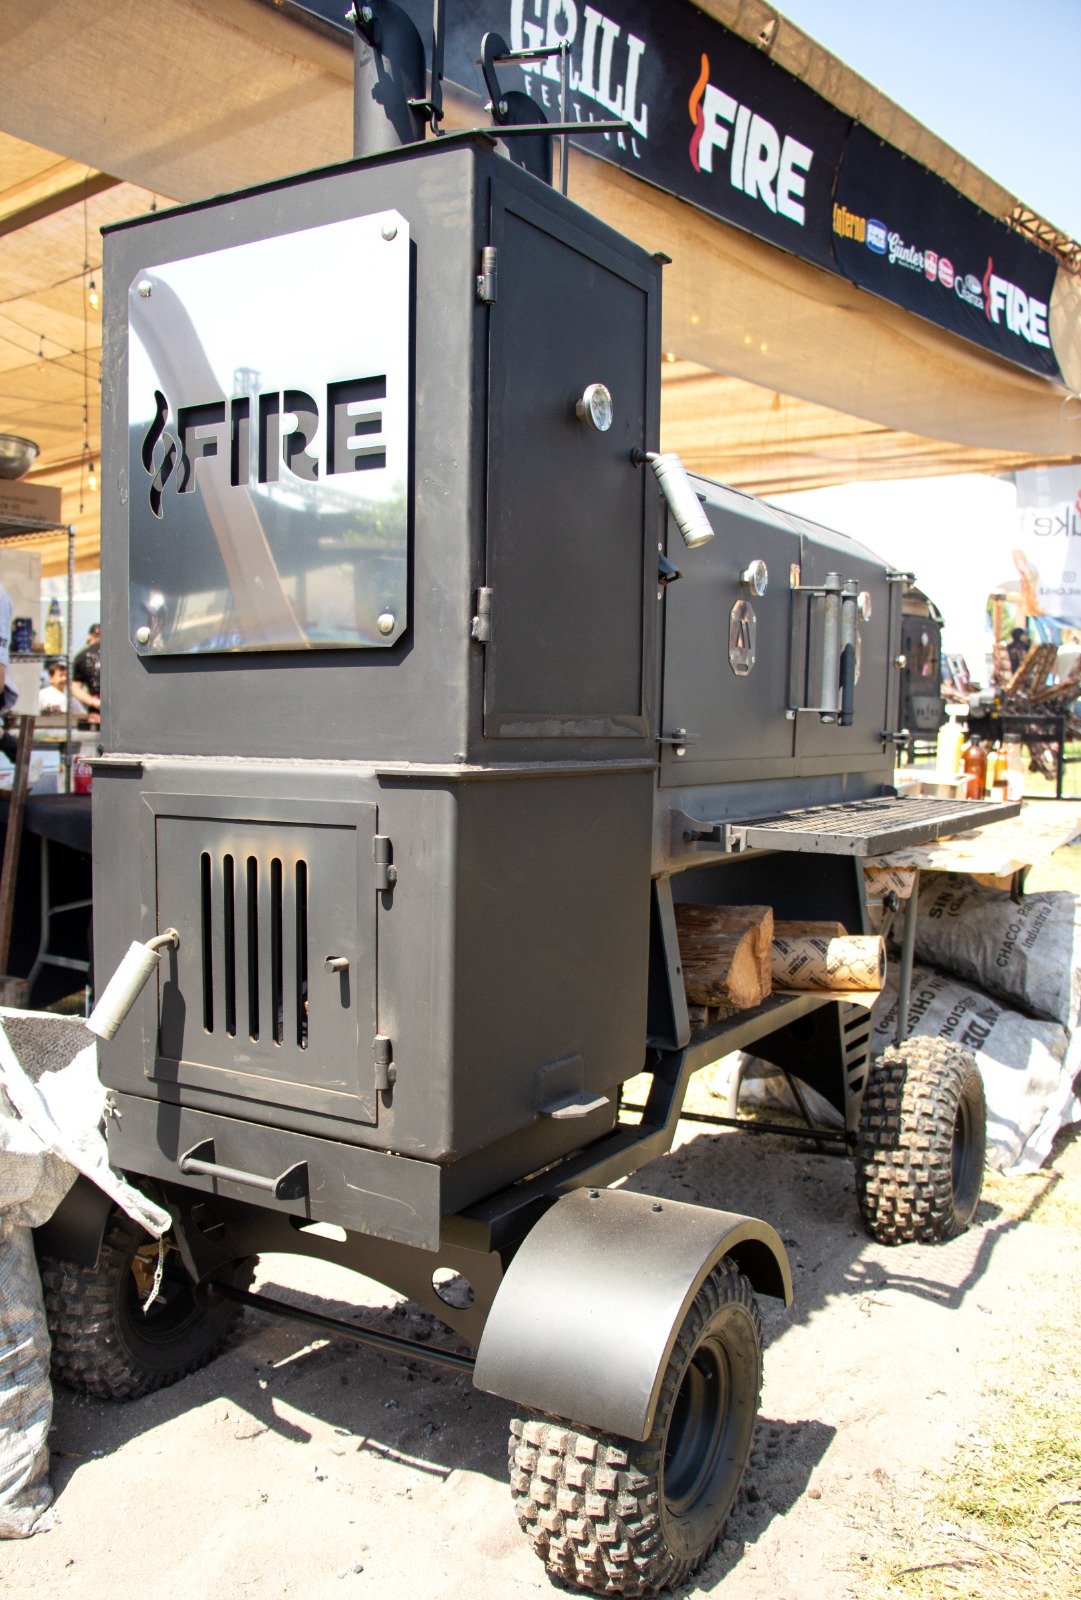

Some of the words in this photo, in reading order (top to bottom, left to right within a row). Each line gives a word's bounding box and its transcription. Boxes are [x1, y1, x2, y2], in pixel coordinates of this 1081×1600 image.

[510, 0, 648, 139] GRILL
[699, 83, 814, 226] FIRE
[989, 274, 1050, 349] FIRE
[177, 374, 387, 494] FIRE
[929, 892, 954, 919] SIN
[996, 924, 1021, 967] CHACO
[960, 1020, 991, 1050] DE
